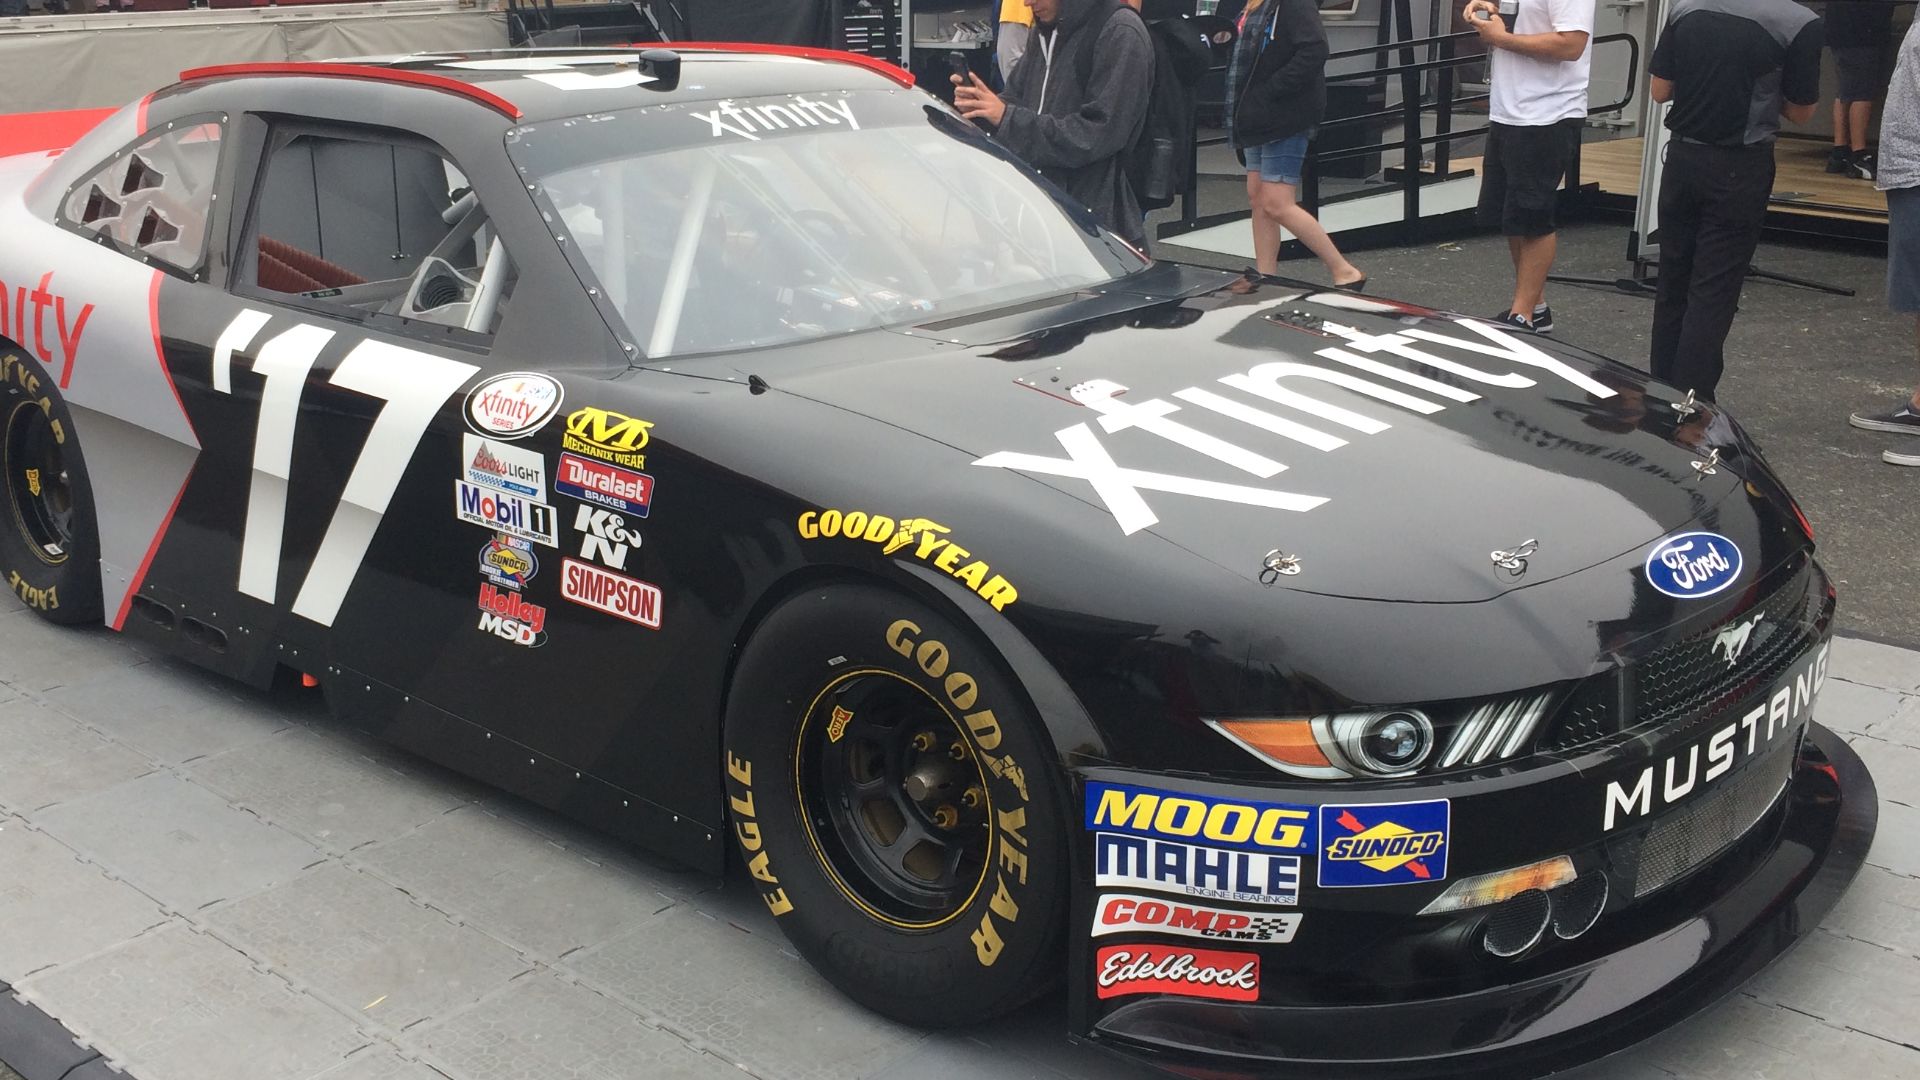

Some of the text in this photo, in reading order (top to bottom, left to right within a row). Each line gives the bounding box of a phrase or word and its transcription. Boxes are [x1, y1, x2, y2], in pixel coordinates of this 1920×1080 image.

[689, 96, 860, 141] xfinity
[478, 390, 537, 427] xfinity
[491, 417, 514, 430] SERIES
[971, 319, 1618, 536] xfinity
[472, 448, 540, 484] Coors LIGHT
[562, 433, 645, 470] MECHANIX WEAR
[565, 458, 645, 502] Duralast
[461, 483, 524, 529] Mobil
[584, 490, 627, 510] BRAKES
[463, 512, 485, 523] OFFICIAL
[485, 519, 504, 530] MOTOR
[504, 524, 514, 533] OIL
[519, 528, 552, 544] LUBRICANTS
[491, 553, 527, 573] SUNOCO
[1661, 540, 1731, 589] Ford
[478, 582, 547, 634] Holley
[566, 564, 657, 622] SIMPSON
[478, 611, 537, 646] MSD
[1603, 642, 1830, 832] MUSTANG
[727, 749, 794, 917] EAGLE
[1094, 789, 1310, 848] MOOG
[1332, 833, 1437, 859] SUNOCO
[1096, 835, 1299, 897] MAHLE
[1185, 885, 1296, 905] ENGINE BEARINGS
[1102, 899, 1251, 931] COMP
[1201, 927, 1272, 941] CAMS
[1099, 950, 1257, 989] Edelbrock
